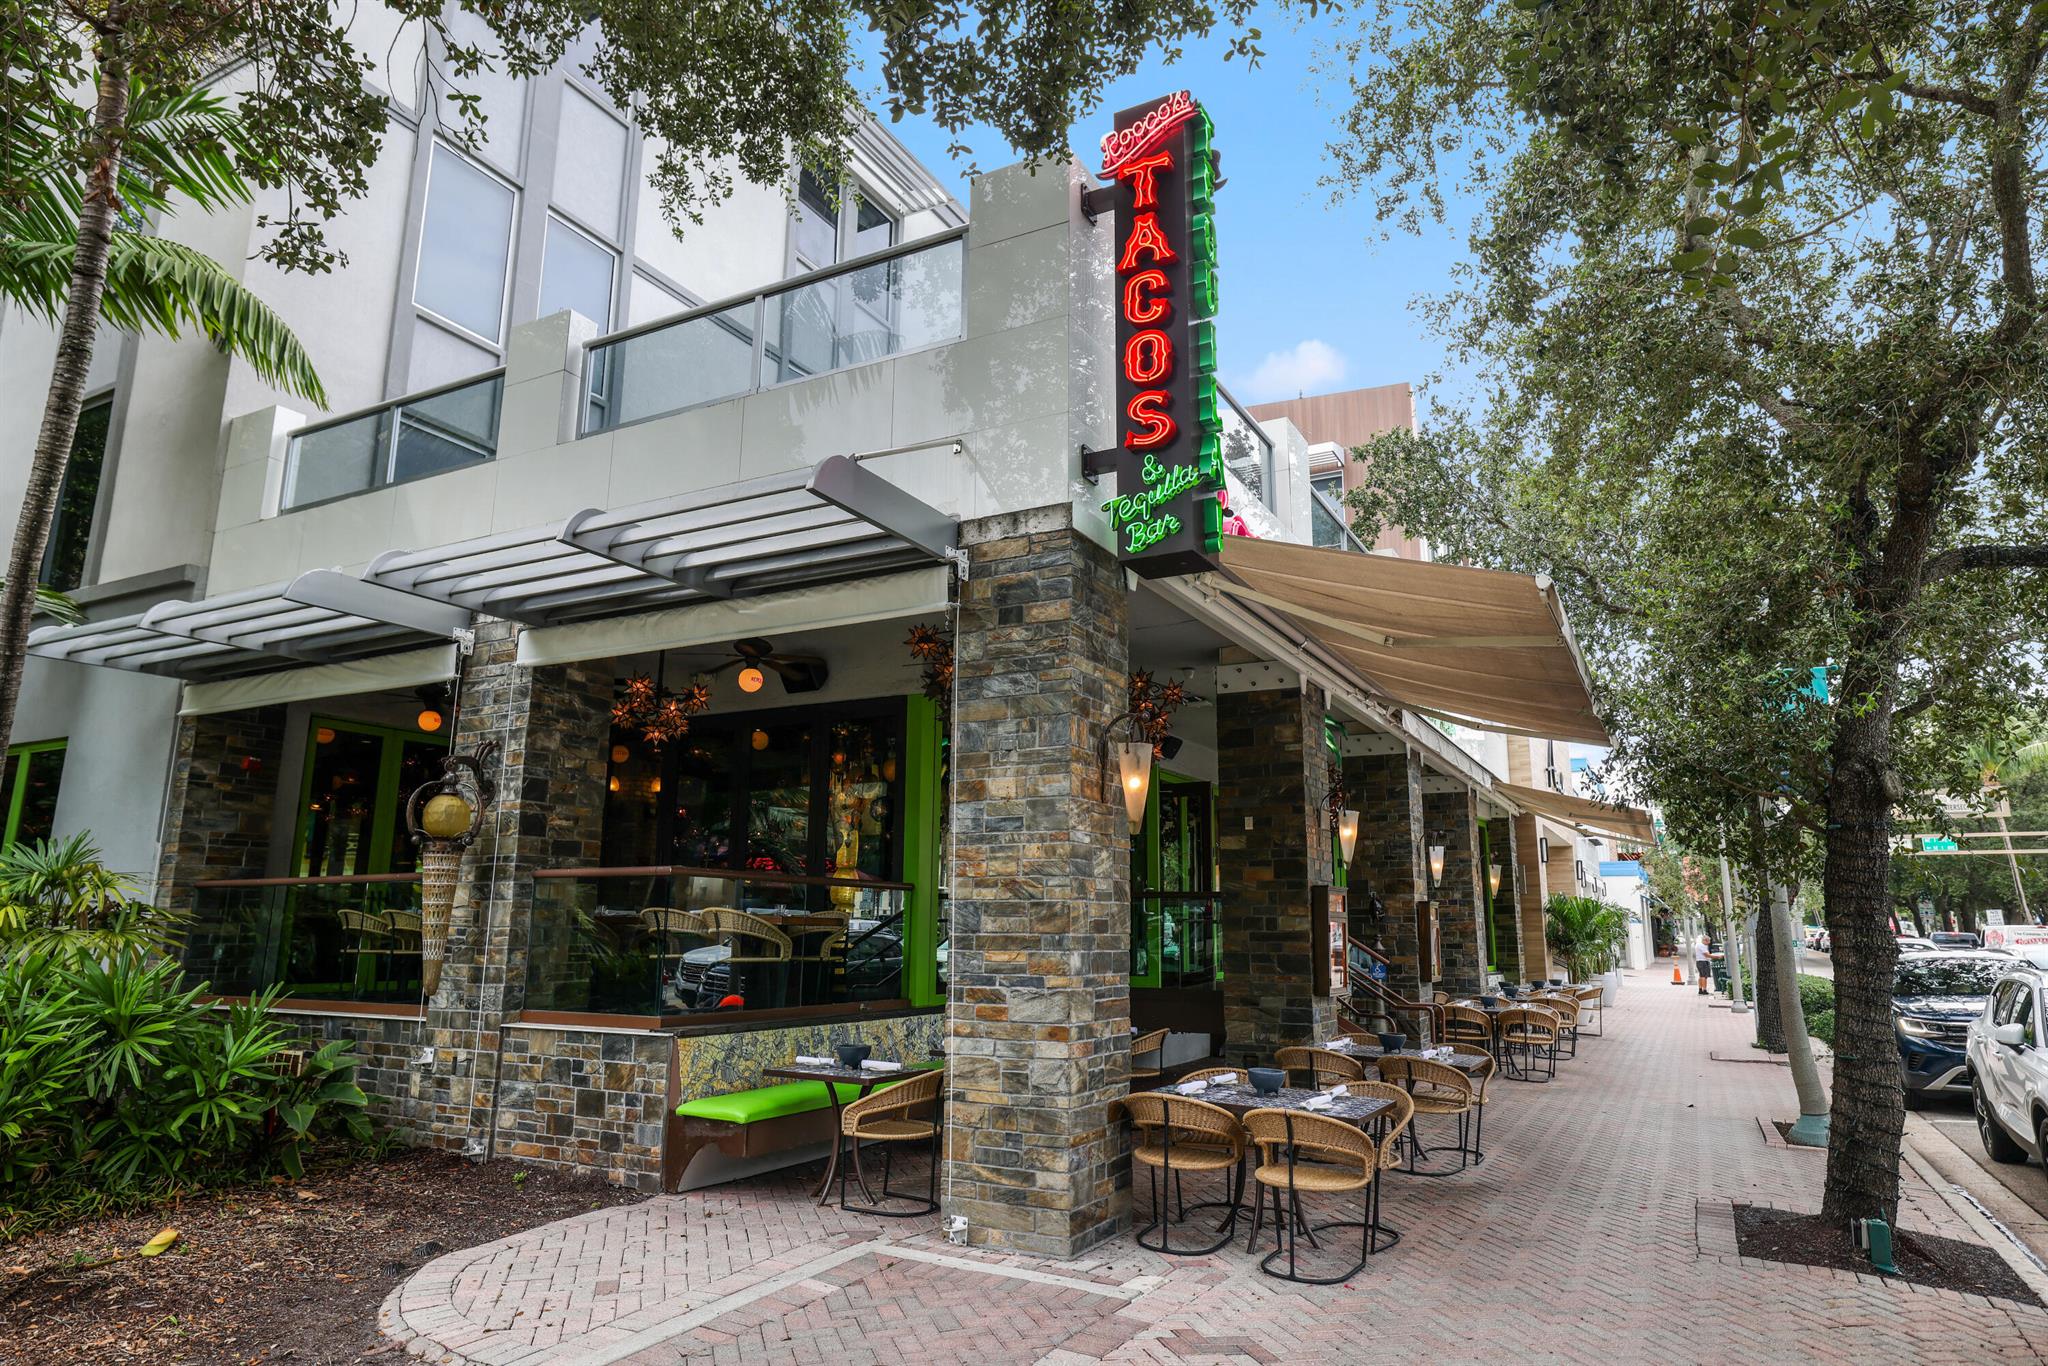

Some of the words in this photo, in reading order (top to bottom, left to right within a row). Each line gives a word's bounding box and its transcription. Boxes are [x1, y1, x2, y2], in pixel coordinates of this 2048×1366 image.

[1099, 90, 1194, 174] Rocco's
[1117, 151, 1178, 453] TACOS
[1101, 465, 1203, 531] Tequila
[1142, 454, 1165, 484] &
[1125, 513, 1182, 554] Bar
